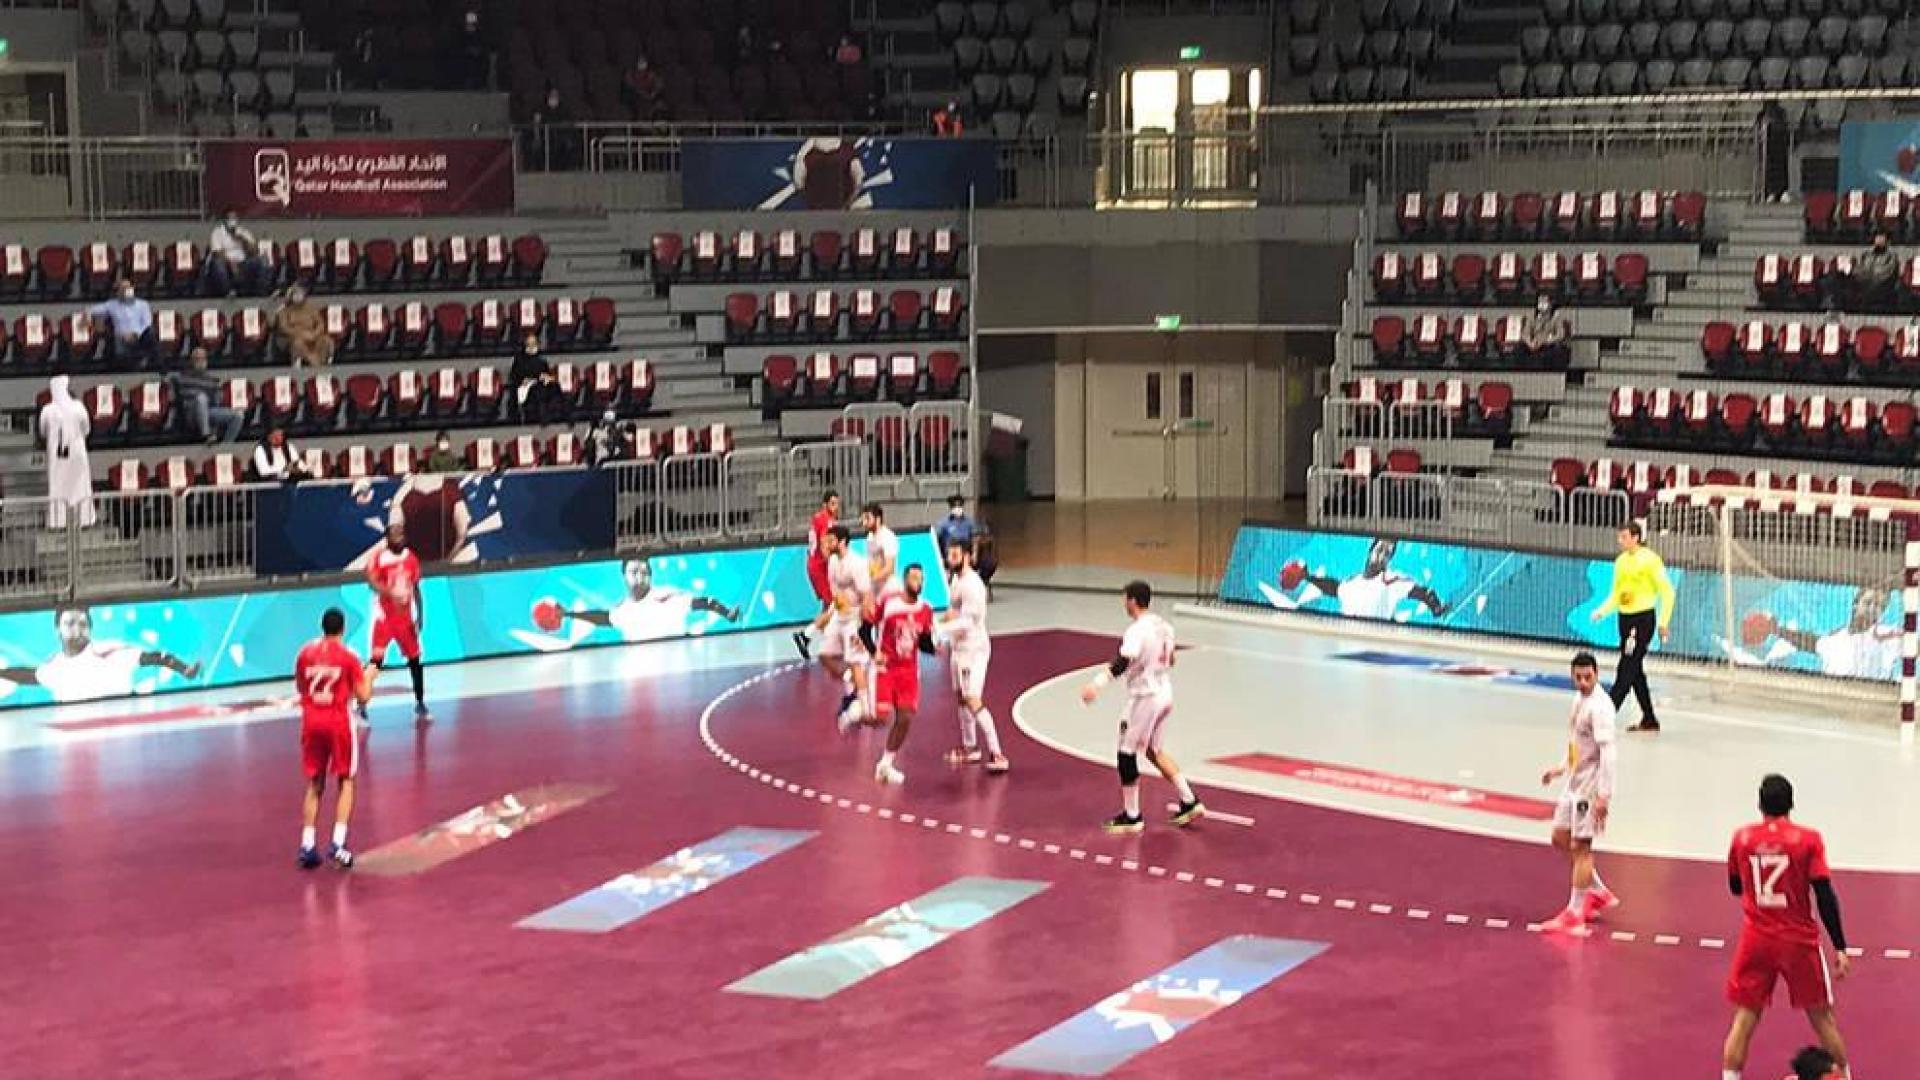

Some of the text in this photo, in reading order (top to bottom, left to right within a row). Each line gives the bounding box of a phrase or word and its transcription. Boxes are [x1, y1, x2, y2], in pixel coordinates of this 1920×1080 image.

[294, 178, 447, 192] Qatar Handball Association
